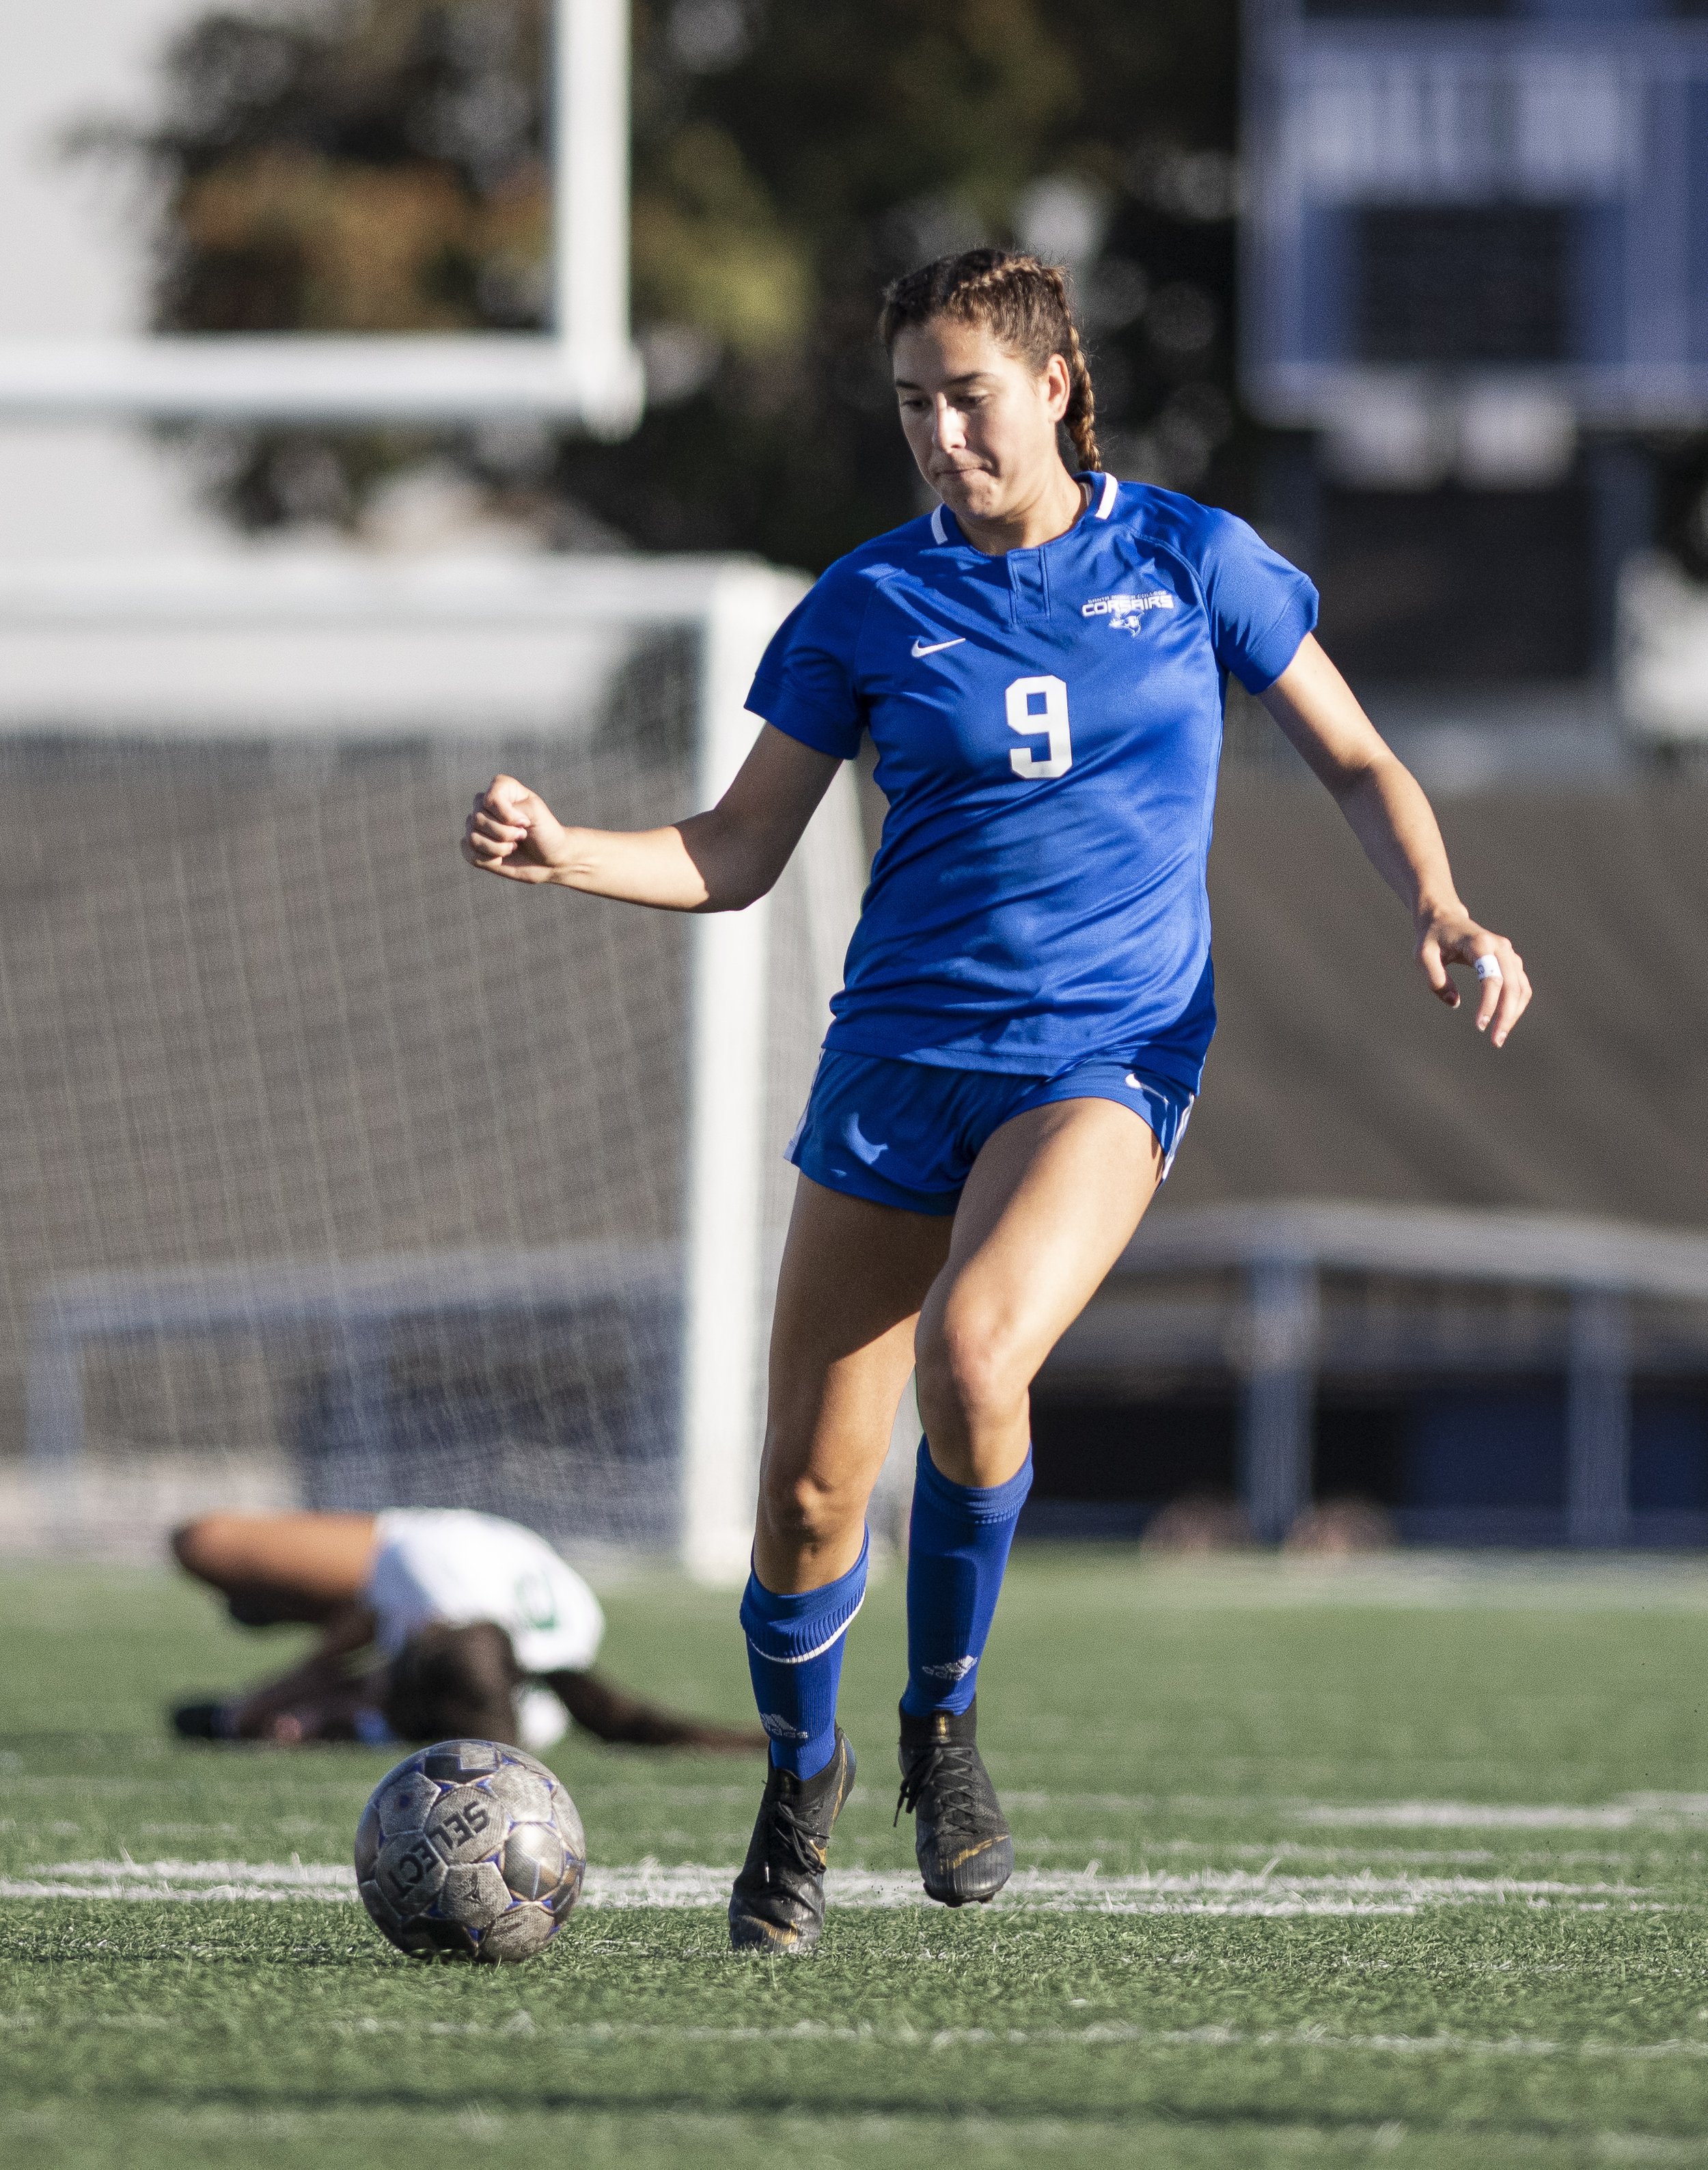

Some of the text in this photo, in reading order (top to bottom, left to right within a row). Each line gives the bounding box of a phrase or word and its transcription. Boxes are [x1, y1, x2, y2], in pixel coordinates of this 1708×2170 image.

[1082, 594, 1174, 617] CORSAIRS
[1005, 674, 1073, 779] 9
[922, 1657, 978, 1681] adid
[387, 1800, 490, 1897] SELECT
